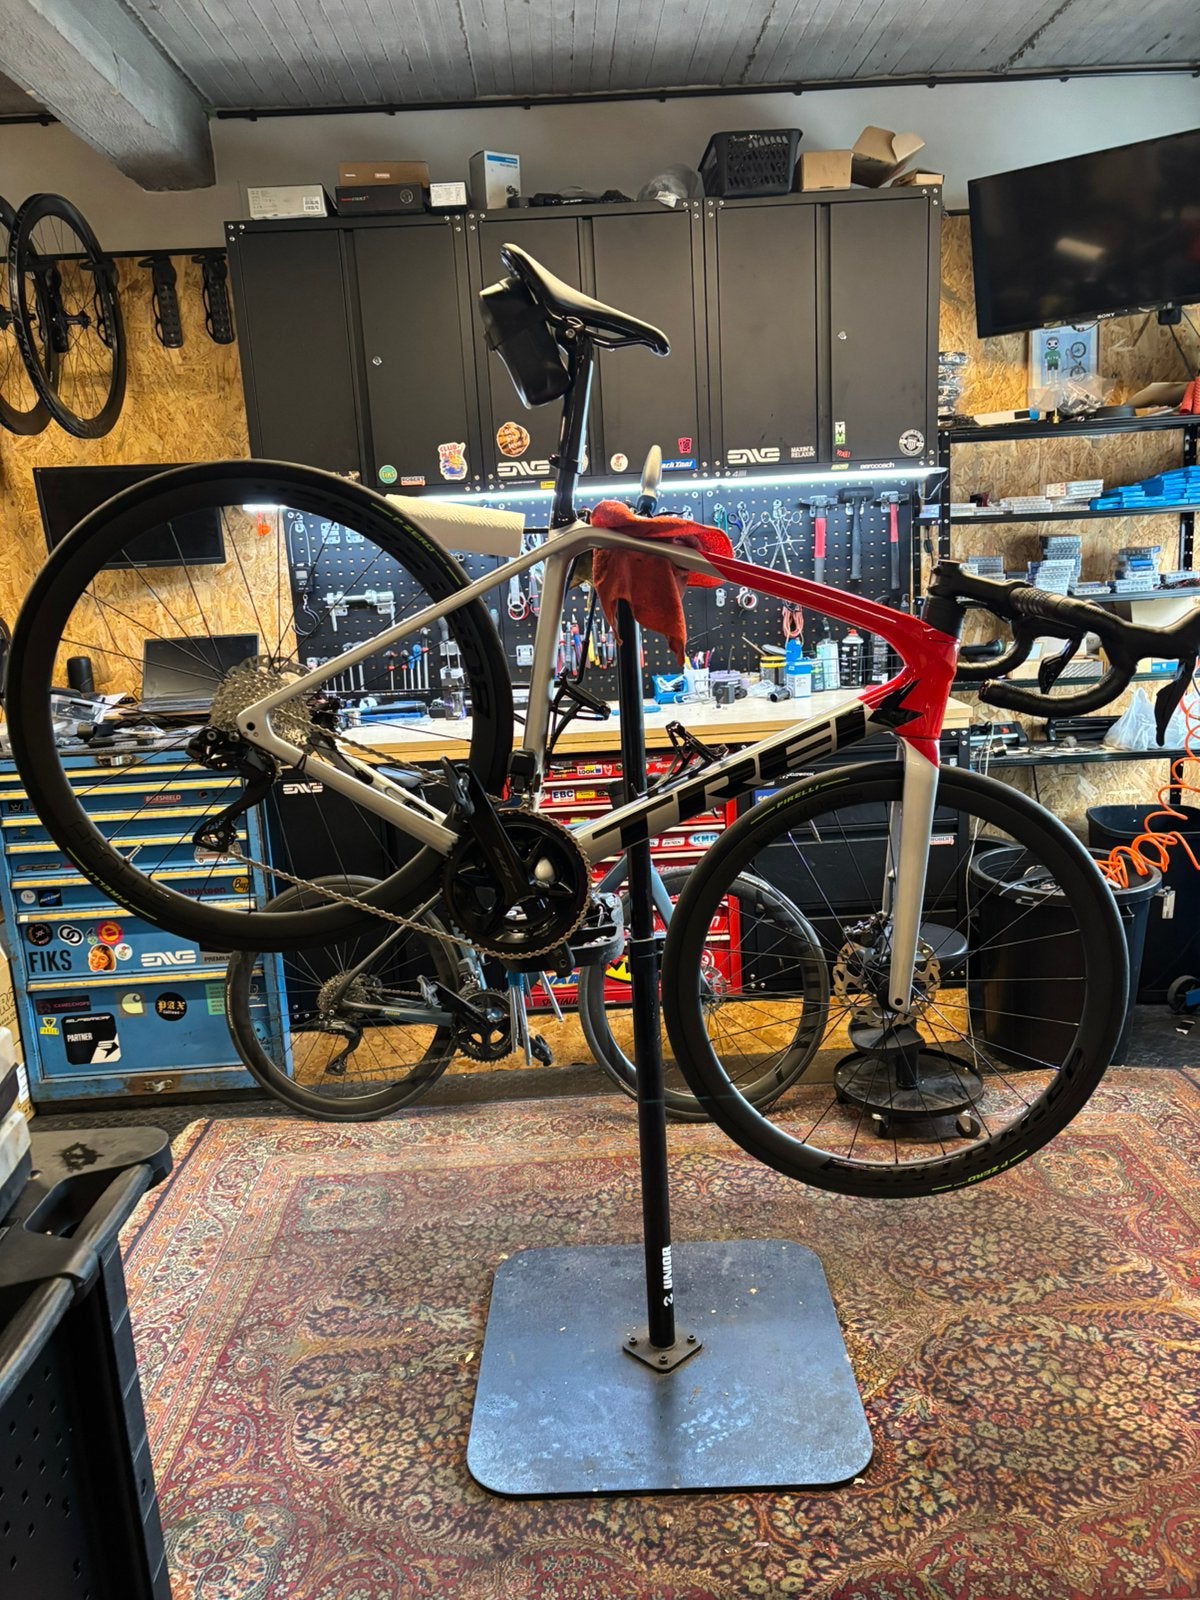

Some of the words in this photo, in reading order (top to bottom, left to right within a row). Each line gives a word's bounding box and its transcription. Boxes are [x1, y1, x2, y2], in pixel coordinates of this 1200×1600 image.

[552, 791, 575, 799] EBC
[776, 784, 820, 809] PIRELLI
[87, 870, 130, 905] PIRELLI
[28, 950, 72, 973] FIKS
[67, 1032, 93, 1042] PARTNER
[662, 1244, 673, 1290] UNIOR
